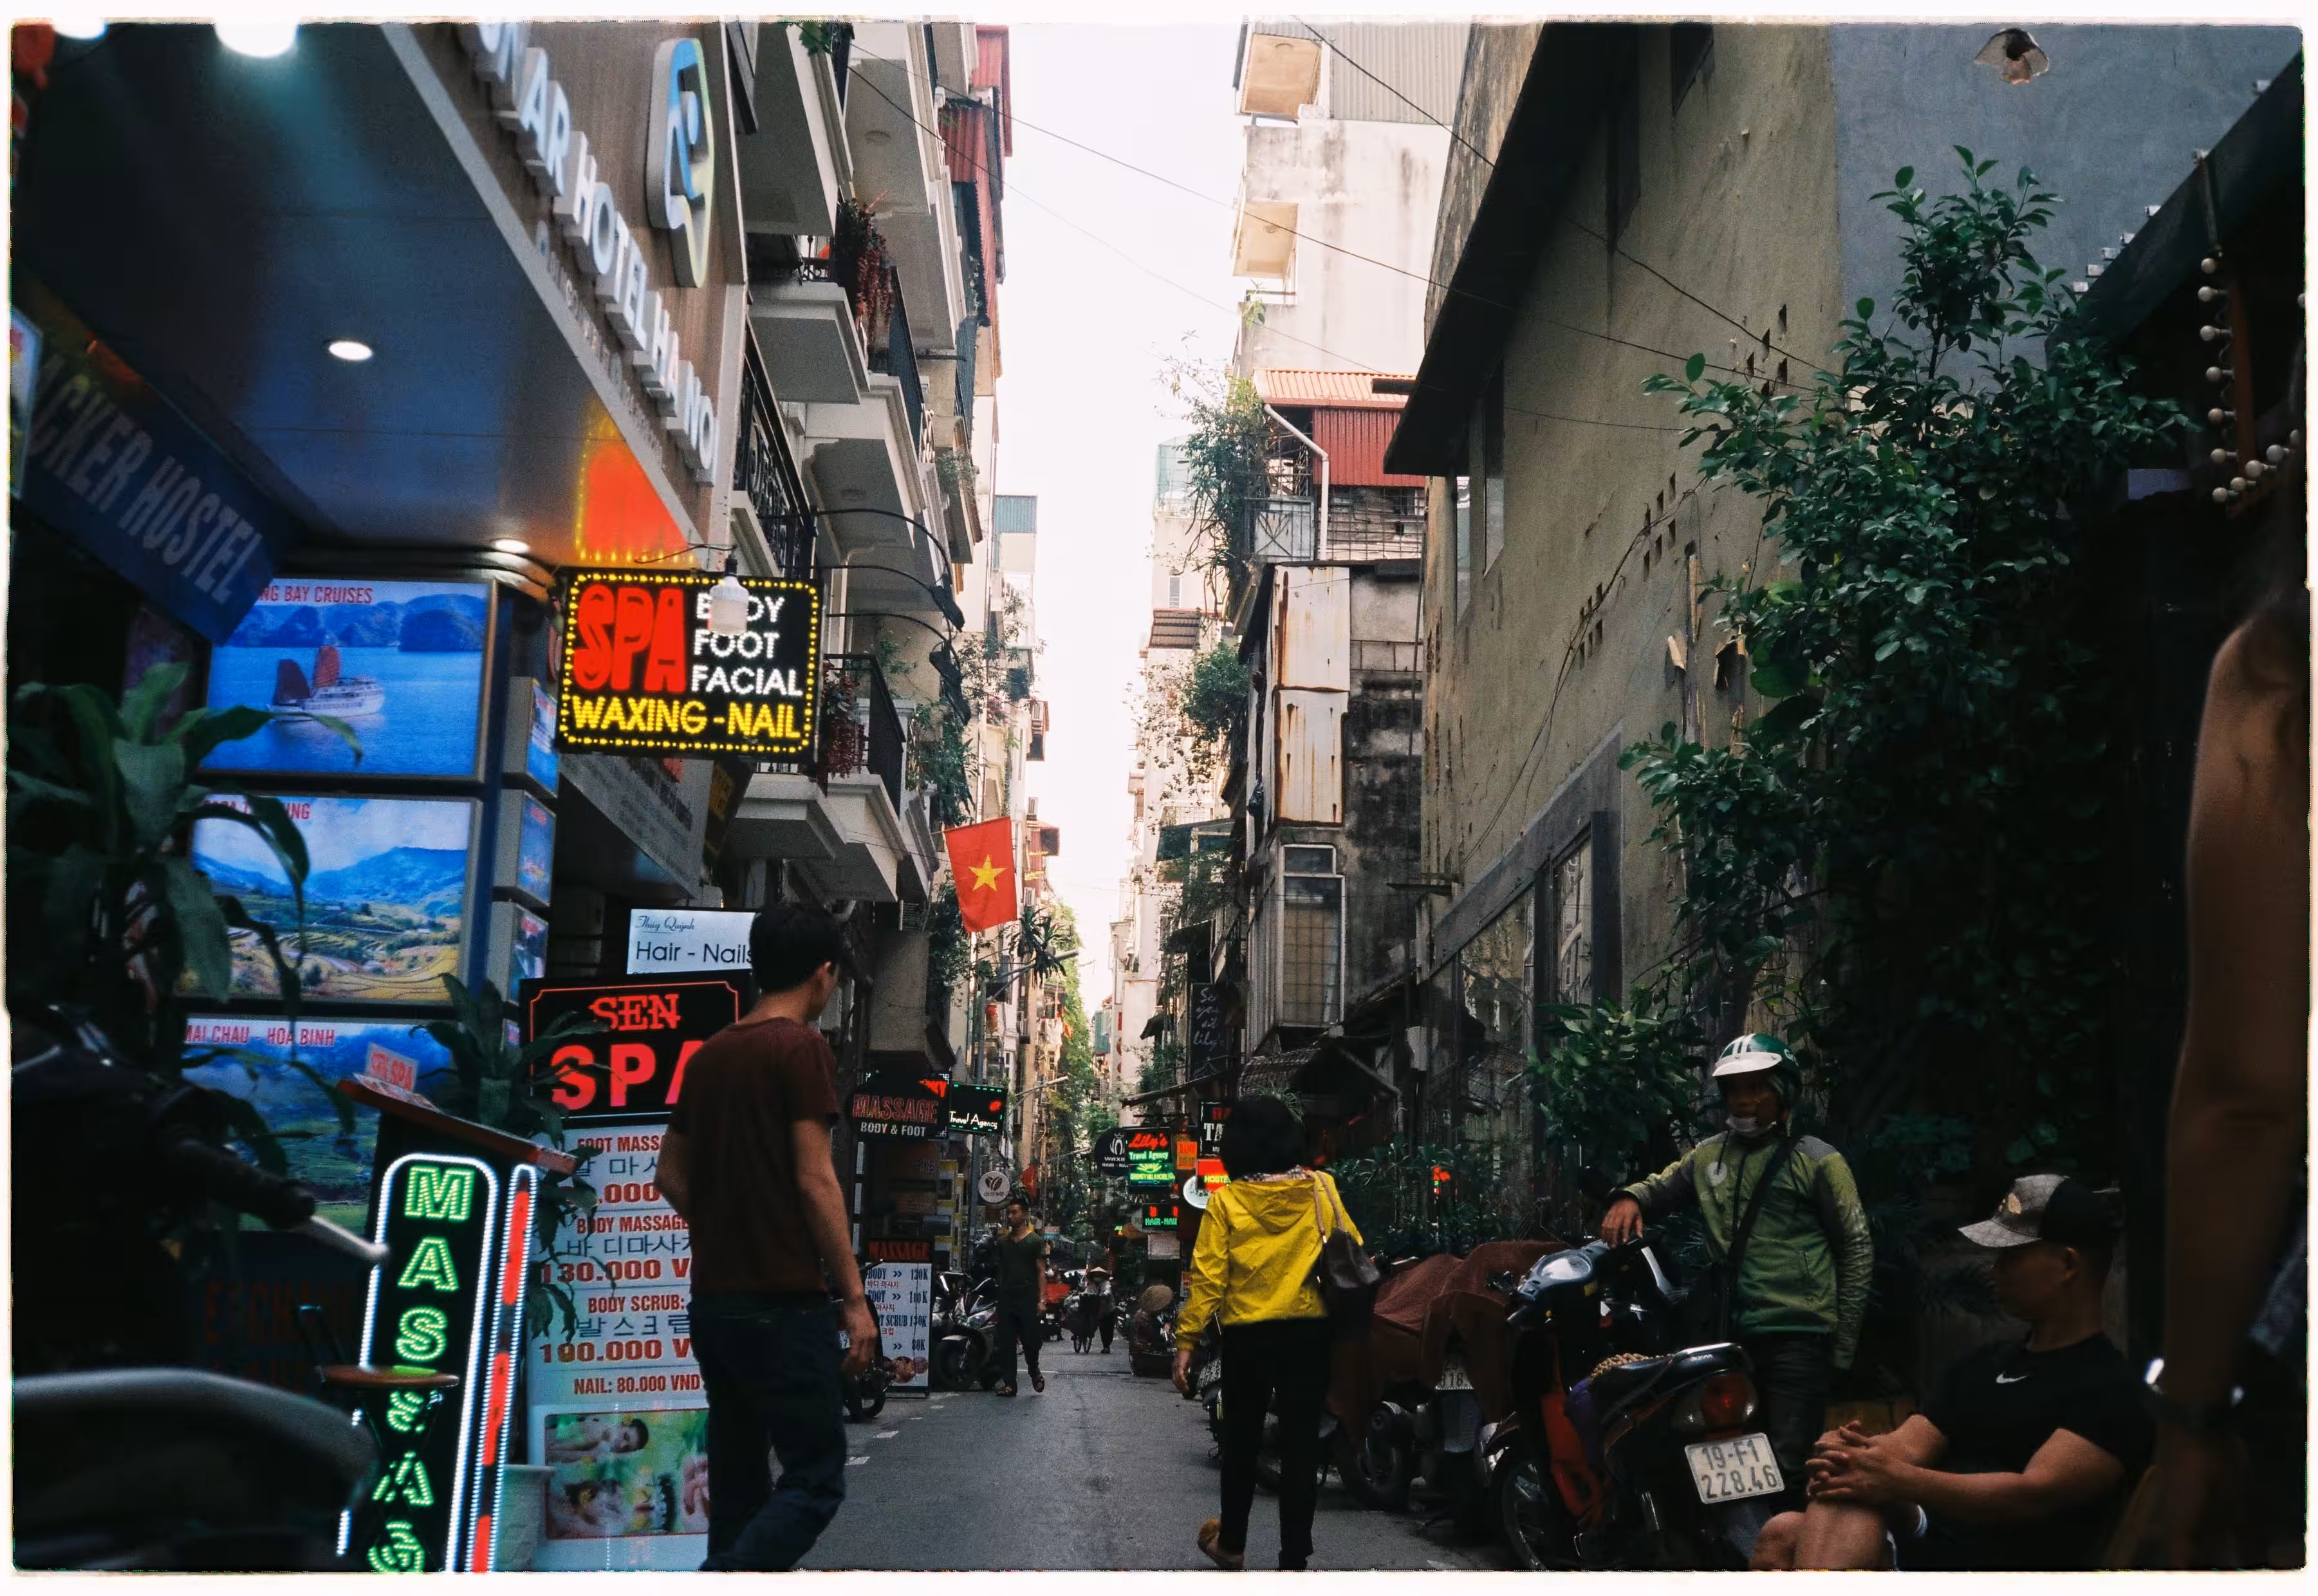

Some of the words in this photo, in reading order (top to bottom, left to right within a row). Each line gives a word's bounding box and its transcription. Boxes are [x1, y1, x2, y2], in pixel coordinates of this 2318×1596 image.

[573, 131, 648, 351] HOTEL
[118, 456, 263, 605] HOSTEL
[284, 586, 310, 602] BAY
[315, 587, 373, 604] CRUISES
[696, 593, 785, 623] BDY
[573, 584, 686, 694] SPA
[694, 631, 780, 658] FOOT
[691, 665, 802, 697] FACIAL
[572, 696, 707, 734] WAXING
[727, 701, 801, 739] NAIL
[636, 942, 681, 961] Hair
[589, 994, 681, 1031] SEN
[211, 1025, 250, 1044] CHAU
[300, 1028, 335, 1046] BINH
[853, 1094, 938, 1124] MASSAGE
[860, 1122, 887, 1134] BODY
[891, 1124, 898, 1135] &
[902, 1126, 926, 1137] FOOT
[949, 1111, 970, 1124] Travel
[970, 1114, 997, 1129] Agency
[577, 1137, 612, 1153] FOOT
[618, 1135, 663, 1153] MASS
[1128, 1133, 1168, 1150] Lily's
[1129, 1151, 1147, 1160] Travel
[1149, 1151, 1169, 1160] Agency
[559, 1182, 661, 1205] .000
[620, 1214, 690, 1232] MASSAGE
[869, 1242, 929, 1258] MASSAGE
[541, 1259, 661, 1283] 130.000
[868, 1268, 887, 1280] BODY
[588, 1296, 625, 1313] BODY
[631, 1295, 685, 1312] SCRUB:
[886, 1315, 908, 1327] SCRUB
[539, 1339, 663, 1363] 100.000
[912, 1339, 925, 1351] 80K
[574, 1377, 612, 1394] NAIL:
[617, 1376, 665, 1393] 80.000
[671, 1374, 700, 1391] VND
[1701, 1439, 1761, 1471] 19-F1
[1701, 1464, 1777, 1500] 228.46
